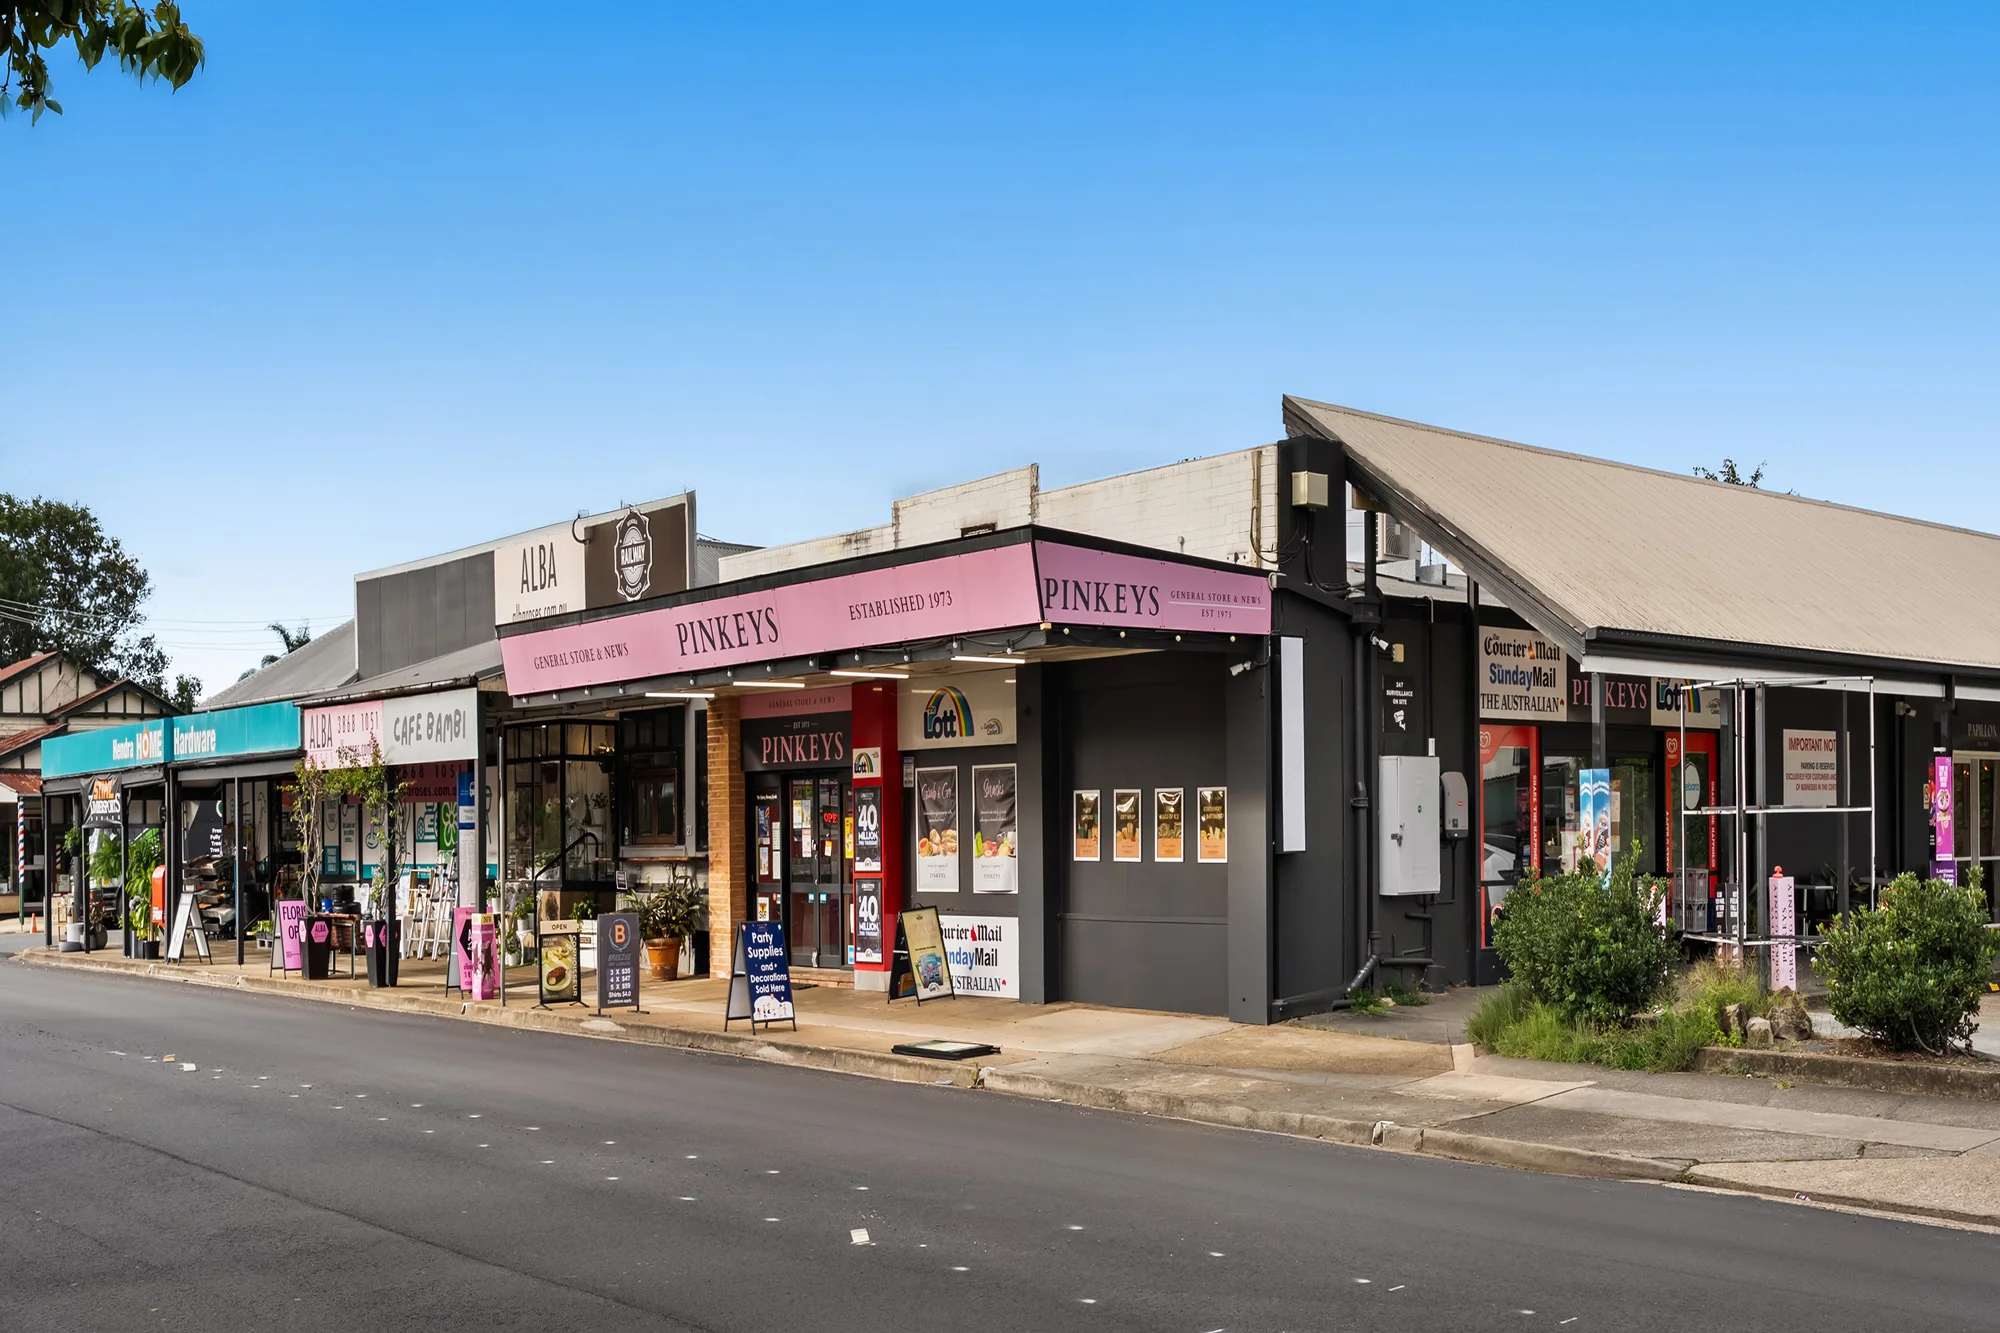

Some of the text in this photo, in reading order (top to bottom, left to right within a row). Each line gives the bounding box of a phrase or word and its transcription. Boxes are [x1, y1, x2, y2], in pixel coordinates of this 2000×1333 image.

[621, 544, 646, 566] RAILWAY
[521, 542, 558, 594] ALBA
[848, 590, 952, 620] ESTABLISHED 1973
[1043, 578, 1160, 616] PINKEYS
[1170, 590, 1204, 600] GENERAL
[1208, 592, 1232, 602] STORE
[1242, 596, 1262, 604] NEWS
[512, 602, 568, 622] albarosescomau
[1202, 609, 1232, 618] EST 1973
[675, 606, 779, 656] PINKEYS
[534, 642, 628, 670] GENERAL STORE & NEWS
[1484, 636, 1560, 661] Courier Mail
[768, 700, 792, 708] GENERAL
[794, 698, 812, 706] STORE
[1480, 693, 1559, 712] THE AUSTRALIAN
[1572, 678, 1647, 710] PIKEYS
[310, 713, 332, 748] ALBA
[338, 712, 379, 734] 3868 1051
[394, 708, 466, 746] CAFE BAMBI
[924, 710, 956, 739] Lott
[1968, 723, 1997, 737] PAPILLON
[112, 729, 162, 760] Hendra HOME
[174, 726, 216, 756] Hardware
[762, 732, 844, 764] PINKEYS
[1789, 738, 1836, 752] IMPORTANT NOT
[402, 765, 424, 778] 868
[93, 780, 115, 800] STIHL
[408, 786, 456, 796] aroses.com.a
[823, 812, 838, 824] OPE
[858, 804, 878, 832] $40
[858, 831, 878, 841] MILLION
[282, 906, 306, 920] FLORI
[858, 895, 878, 922] $40
[288, 926, 299, 940] OP
[315, 924, 326, 933] ALBA
[614, 924, 626, 943] B
[858, 922, 878, 931] MILLION
[977, 924, 1002, 942] Mail
[752, 932, 774, 944] Party
[748, 946, 783, 960] Supplies
[946, 947, 998, 971] ndayMail
[760, 962, 774, 972] and
[750, 974, 787, 984] Decorations
[952, 975, 1000, 992] USTRALIAN
[756, 984, 785, 994] Sold Here
